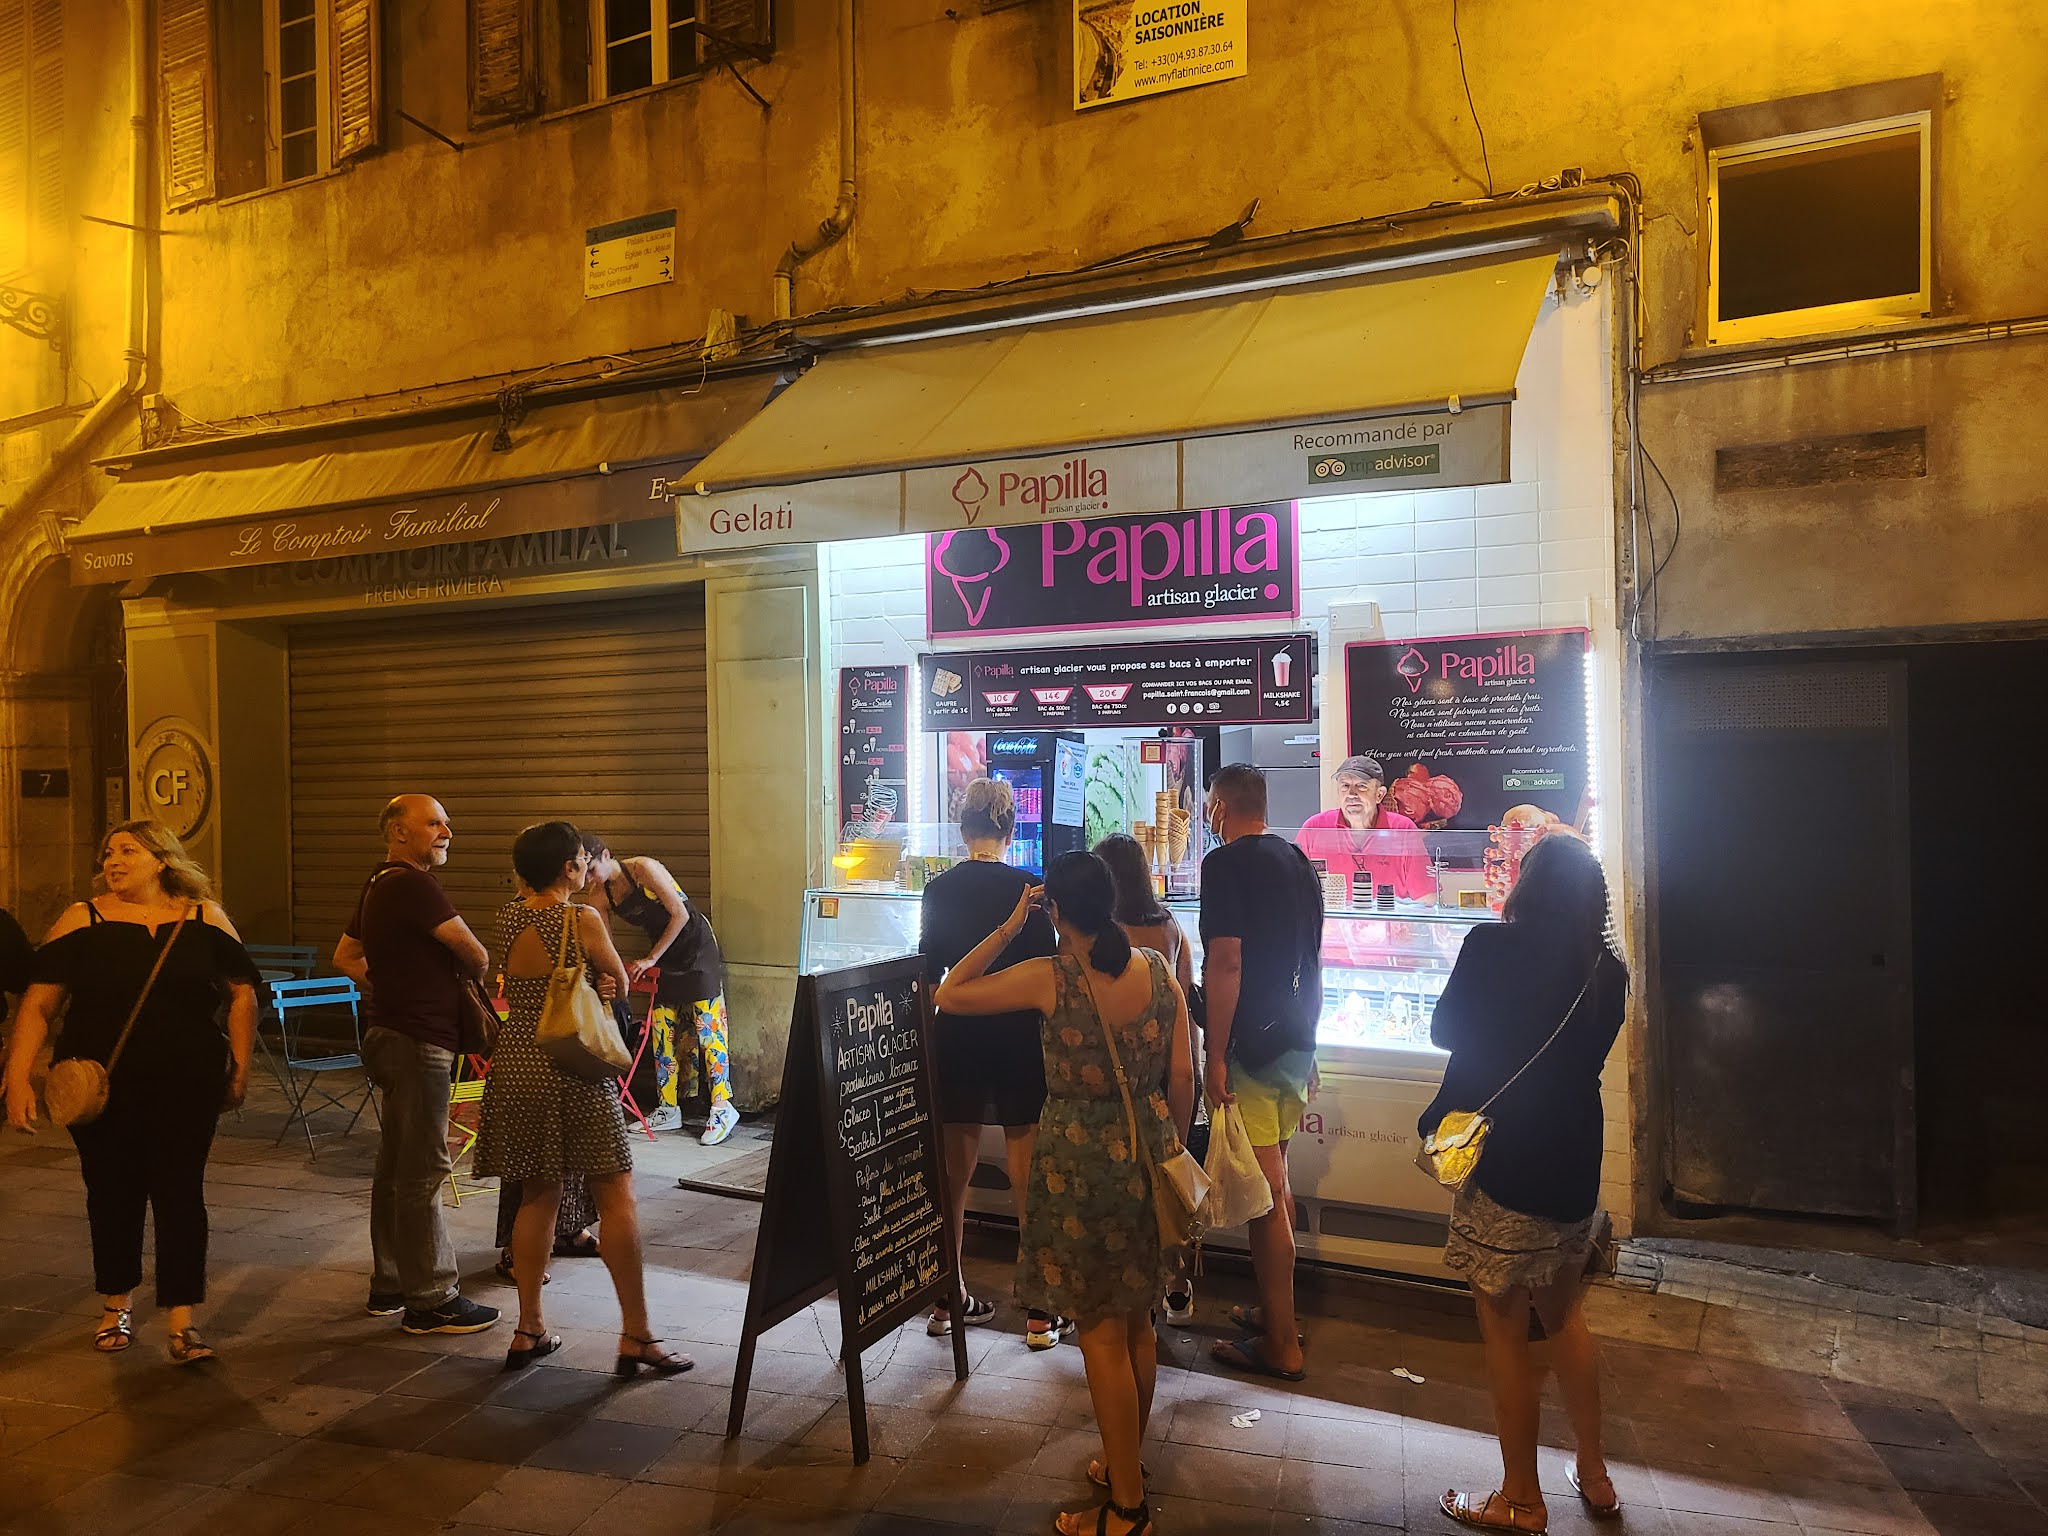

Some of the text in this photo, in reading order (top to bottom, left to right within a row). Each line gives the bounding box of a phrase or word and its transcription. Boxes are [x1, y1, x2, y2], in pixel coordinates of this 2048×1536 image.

[1135, 1, 1200, 28] LOCATION
[1135, 13, 1224, 45] SAISONNIÈRE
[1134, 41, 1233, 71] Tel: +33(0)4.93.87.30.64
[1134, 58, 1234, 88] www.myflatinnice.com
[643, 247, 652, 255] du
[1293, 421, 1453, 451] Recommandé par
[999, 461, 1108, 515] Papilla
[709, 501, 794, 535] Gelati
[1048, 500, 1101, 514] artisan glacier
[230, 498, 501, 558] Le Comptoir Familial
[469, 522, 627, 572] FAMILIAL
[1042, 508, 1278, 607] Papilla
[84, 551, 133, 570] Savons
[365, 574, 504, 604] FRENCH RIVIERA
[1147, 583, 1258, 608] artisan glacier
[984, 657, 1252, 679] Papilla artisan glacier vous propose ses bacs à emporter
[1441, 645, 1535, 686] Papilla
[864, 676, 897, 694] Papilla
[1263, 691, 1301, 699] MILKSHAKE
[1484, 677, 1528, 687] artisan glacier
[933, 707, 950, 716] partir
[1389, 708, 1410, 719] Nos
[1411, 708, 1436, 717] sorbets
[1437, 707, 1454, 716] sont
[1453, 707, 1487, 719] fabriqués
[1519, 704, 1543, 716] fruits.
[1391, 692, 1543, 708] Nos glaces sont à base de produits frais.
[1400, 719, 1426, 730] Nous
[1447, 730, 1456, 738] ni
[1458, 728, 1496, 737] exhausteur
[1497, 727, 1507, 735] de
[1507, 726, 1529, 738] goût.
[1364, 748, 1386, 759] Here
[1385, 751, 1402, 760] you
[1403, 748, 1419, 757] will
[1417, 748, 1435, 760] find
[1456, 746, 1489, 756] authentic
[1490, 745, 1506, 755] and
[1506, 744, 1536, 754] natural
[1536, 743, 1579, 756] ingredients.
[39, 773, 51, 794] 7
[152, 769, 187, 805] CF
[846, 992, 895, 1041] Papilla
[878, 1029, 919, 1059] GLACIER
[839, 1057, 919, 1106] producteurs locaux
[843, 1105, 871, 1129] Glaces
[847, 1129, 877, 1157] Sorbets
[1328, 1126, 1409, 1145] artisan glacier
[882, 1156, 894, 1175] du
[865, 1258, 904, 1296] MILKSHAKE
[905, 1249, 916, 1268] 30
